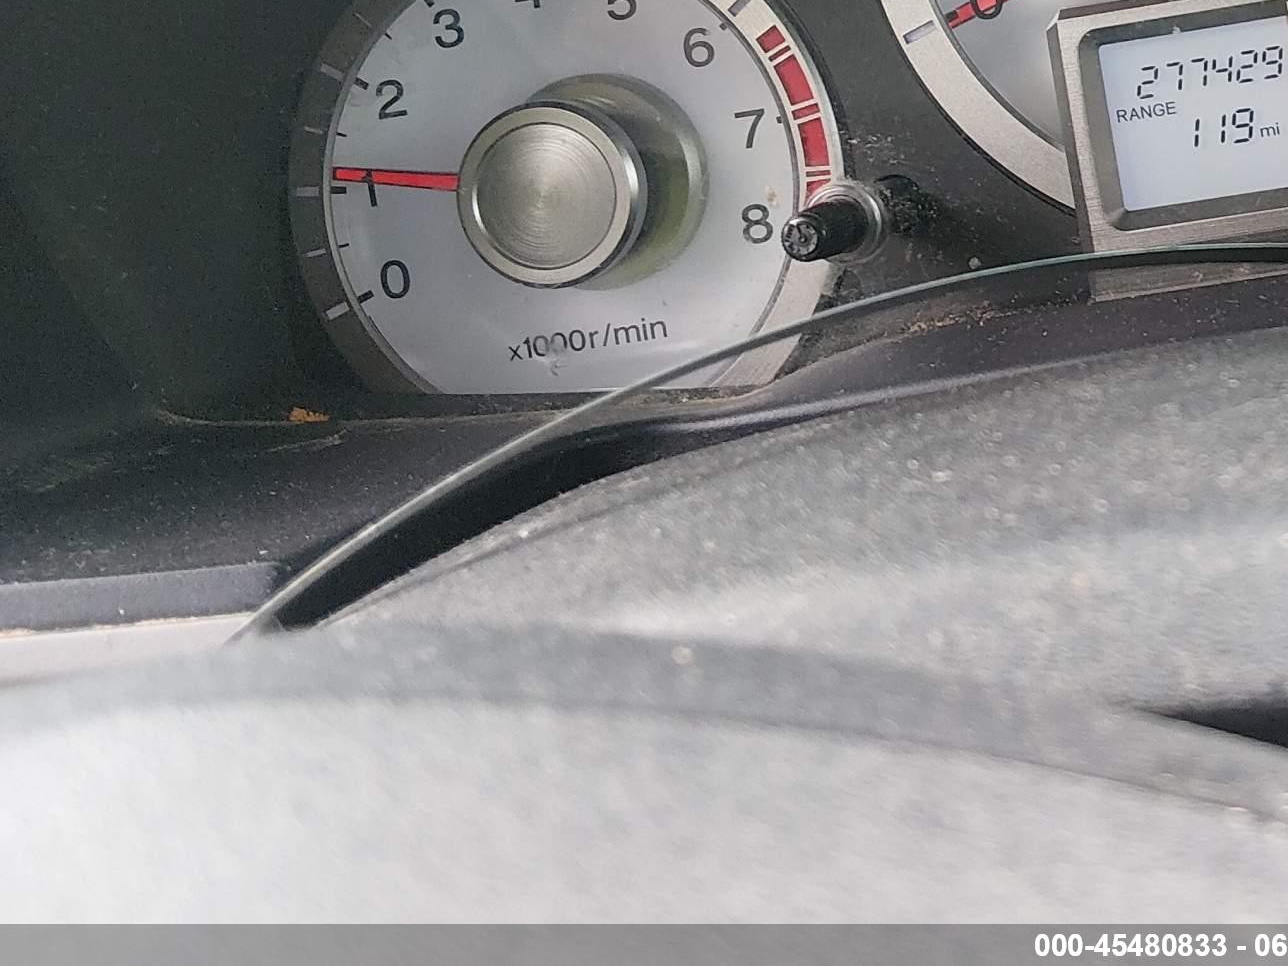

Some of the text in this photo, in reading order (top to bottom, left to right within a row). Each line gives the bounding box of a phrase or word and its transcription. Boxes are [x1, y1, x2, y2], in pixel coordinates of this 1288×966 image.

[432, 9, 465, 48] 3
[683, 28, 715, 67] 6
[1137, 45, 1284, 100] 277429
[375, 80, 407, 120] 2
[1116, 102, 1177, 124] RANGE
[735, 109, 765, 148] 7
[1193, 108, 1280, 148] 119 mi
[362, 170, 377, 207] 1
[741, 204, 773, 244] 8
[380, 260, 410, 299] 0
[507, 318, 668, 361] x1000r/min
